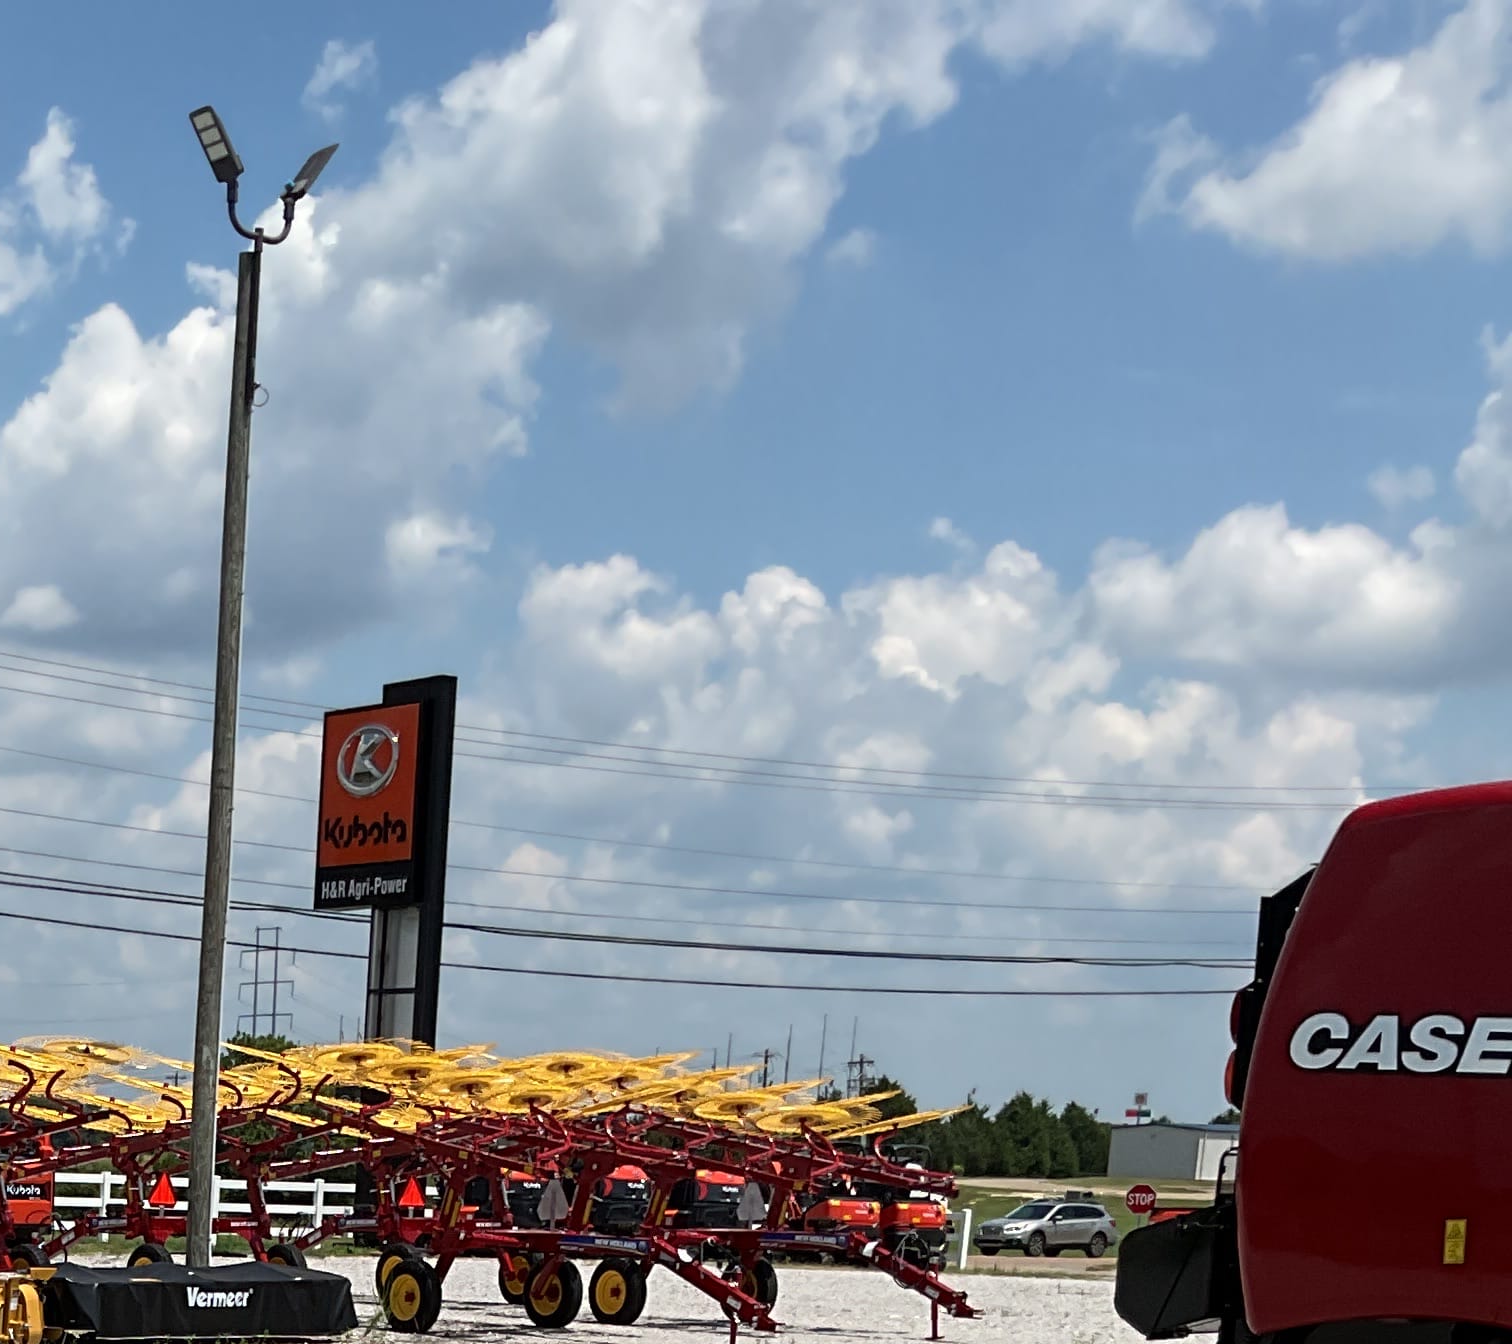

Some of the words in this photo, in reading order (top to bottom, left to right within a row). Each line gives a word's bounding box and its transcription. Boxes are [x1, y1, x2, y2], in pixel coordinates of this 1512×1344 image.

[324, 811, 407, 849] Kubota
[321, 880, 347, 900] H&R
[348, 876, 408, 900] Agri-Power
[1290, 1012, 1512, 1074] CASE
[6, 1185, 41, 1195] Kubota
[1127, 1193, 1154, 1206] STOP
[186, 1286, 249, 1307] Vermeer
